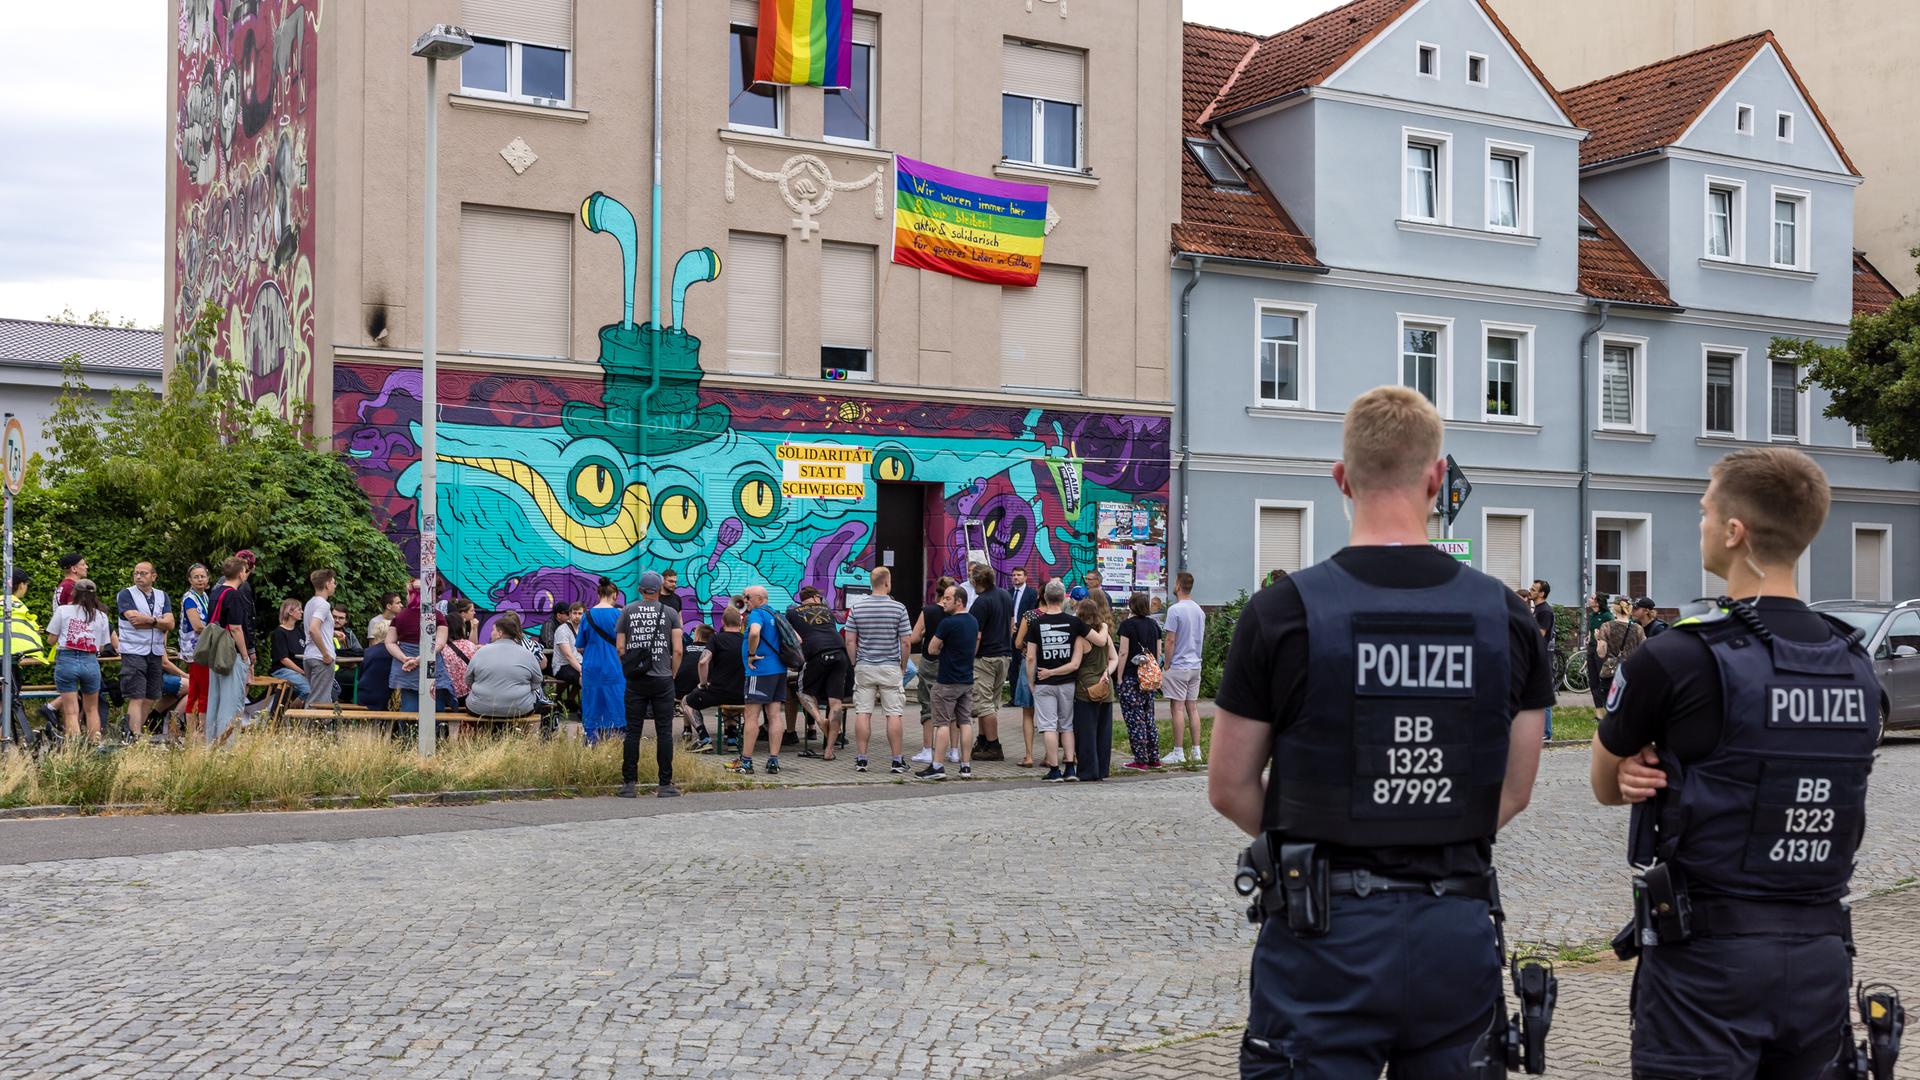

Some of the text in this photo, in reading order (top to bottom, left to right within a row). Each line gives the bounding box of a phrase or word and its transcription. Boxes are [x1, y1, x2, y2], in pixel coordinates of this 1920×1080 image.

[913, 175, 1026, 216] Wir waren immer hier
[914, 196, 924, 213] &
[913, 219, 1000, 248] aktiv & solidarisch
[800, 465, 844, 478] STATT
[1065, 461, 1080, 495] ECLAIM
[782, 482, 865, 496] SCHWEIGEN
[629, 611, 666, 620] WATER'S
[629, 619, 640, 627] AT
[631, 633, 665, 641] THER'S
[633, 626, 660, 634] NECK,
[1043, 648, 1071, 660] DPM
[1357, 642, 1473, 689] POLIZEI
[1771, 687, 1867, 723] POLIZEI
[1394, 716, 1434, 743] BB
[1386, 747, 1444, 775] 1323
[1373, 777, 1453, 805] 87992
[1795, 777, 1832, 803] BB
[1784, 807, 1836, 833] 1323
[1768, 838, 1832, 863] 61310
